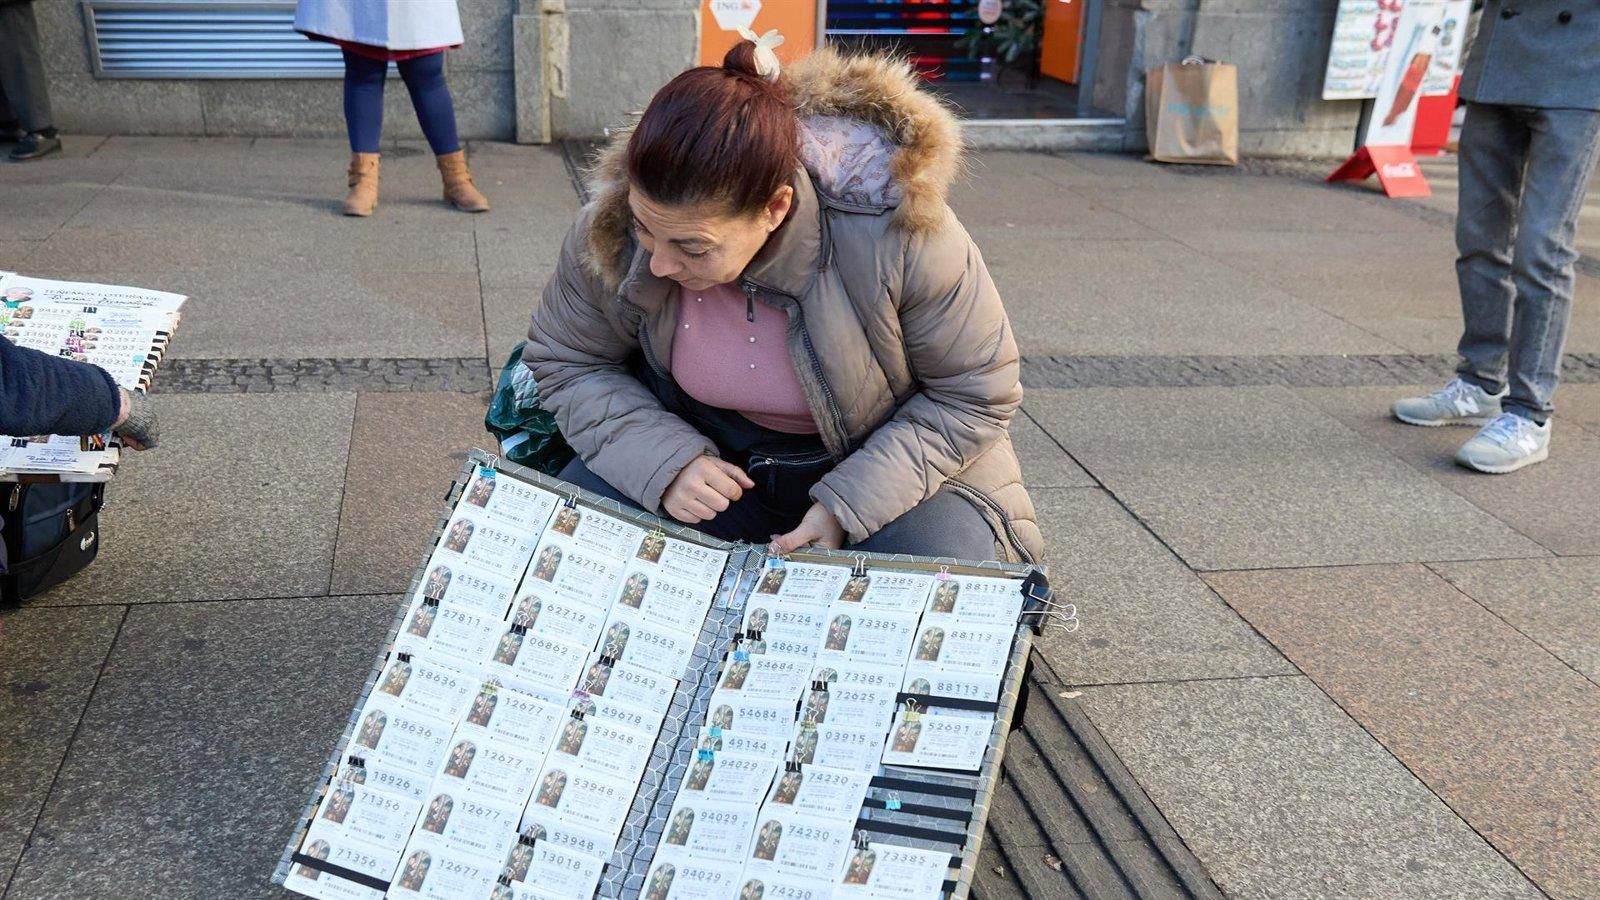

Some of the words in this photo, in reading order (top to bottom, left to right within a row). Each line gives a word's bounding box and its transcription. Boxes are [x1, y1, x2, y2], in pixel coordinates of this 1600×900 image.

[502, 483, 538, 501] 41521
[586, 514, 624, 532] 62712
[480, 527, 517, 546] 41521
[671, 542, 709, 559] 20543
[567, 554, 606, 574] 62712
[792, 568, 828, 578] 95724
[876, 576, 913, 585] 73385
[457, 574, 495, 593] 41521
[655, 581, 693, 599] 20543
[965, 583, 1006, 593] 88113
[442, 609, 481, 627] 27811
[547, 604, 586, 623] 62712
[774, 612, 811, 623] 95724
[858, 618, 897, 630] 73385
[635, 630, 675, 649] 20543
[951, 631, 992, 641] 88113
[529, 637, 568, 656] 06862
[771, 641, 808, 653] 48634
[757, 661, 793, 670] 54684
[418, 668, 456, 688] 58636
[617, 669, 657, 689] 20543
[844, 672, 884, 684] 73385
[836, 690, 875, 701] 72625
[937, 682, 978, 695] 88113
[505, 697, 543, 716] 12677
[739, 708, 776, 719] 54684
[602, 707, 642, 724] 49678
[393, 718, 432, 737] 58636
[593, 725, 633, 745] 53948
[928, 722, 969, 733] 52691
[728, 739, 767, 750] 49144
[825, 731, 865, 743] 03915
[484, 749, 522, 769] 12677
[721, 759, 758, 770] 94029
[373, 771, 410, 789] 18926
[809, 772, 848, 784] 74230
[573, 778, 614, 796] 53948
[361, 792, 400, 811] 71356
[462, 802, 500, 820] 12677
[701, 811, 738, 823] 94029
[788, 825, 829, 840] 74230
[553, 832, 594, 851] 53948
[337, 848, 376, 868] 71356
[542, 851, 581, 870] 13018
[884, 851, 926, 864] 73385
[440, 859, 478, 877] 12677
[682, 868, 721, 881] 94029
[770, 885, 812, 900] 74230
